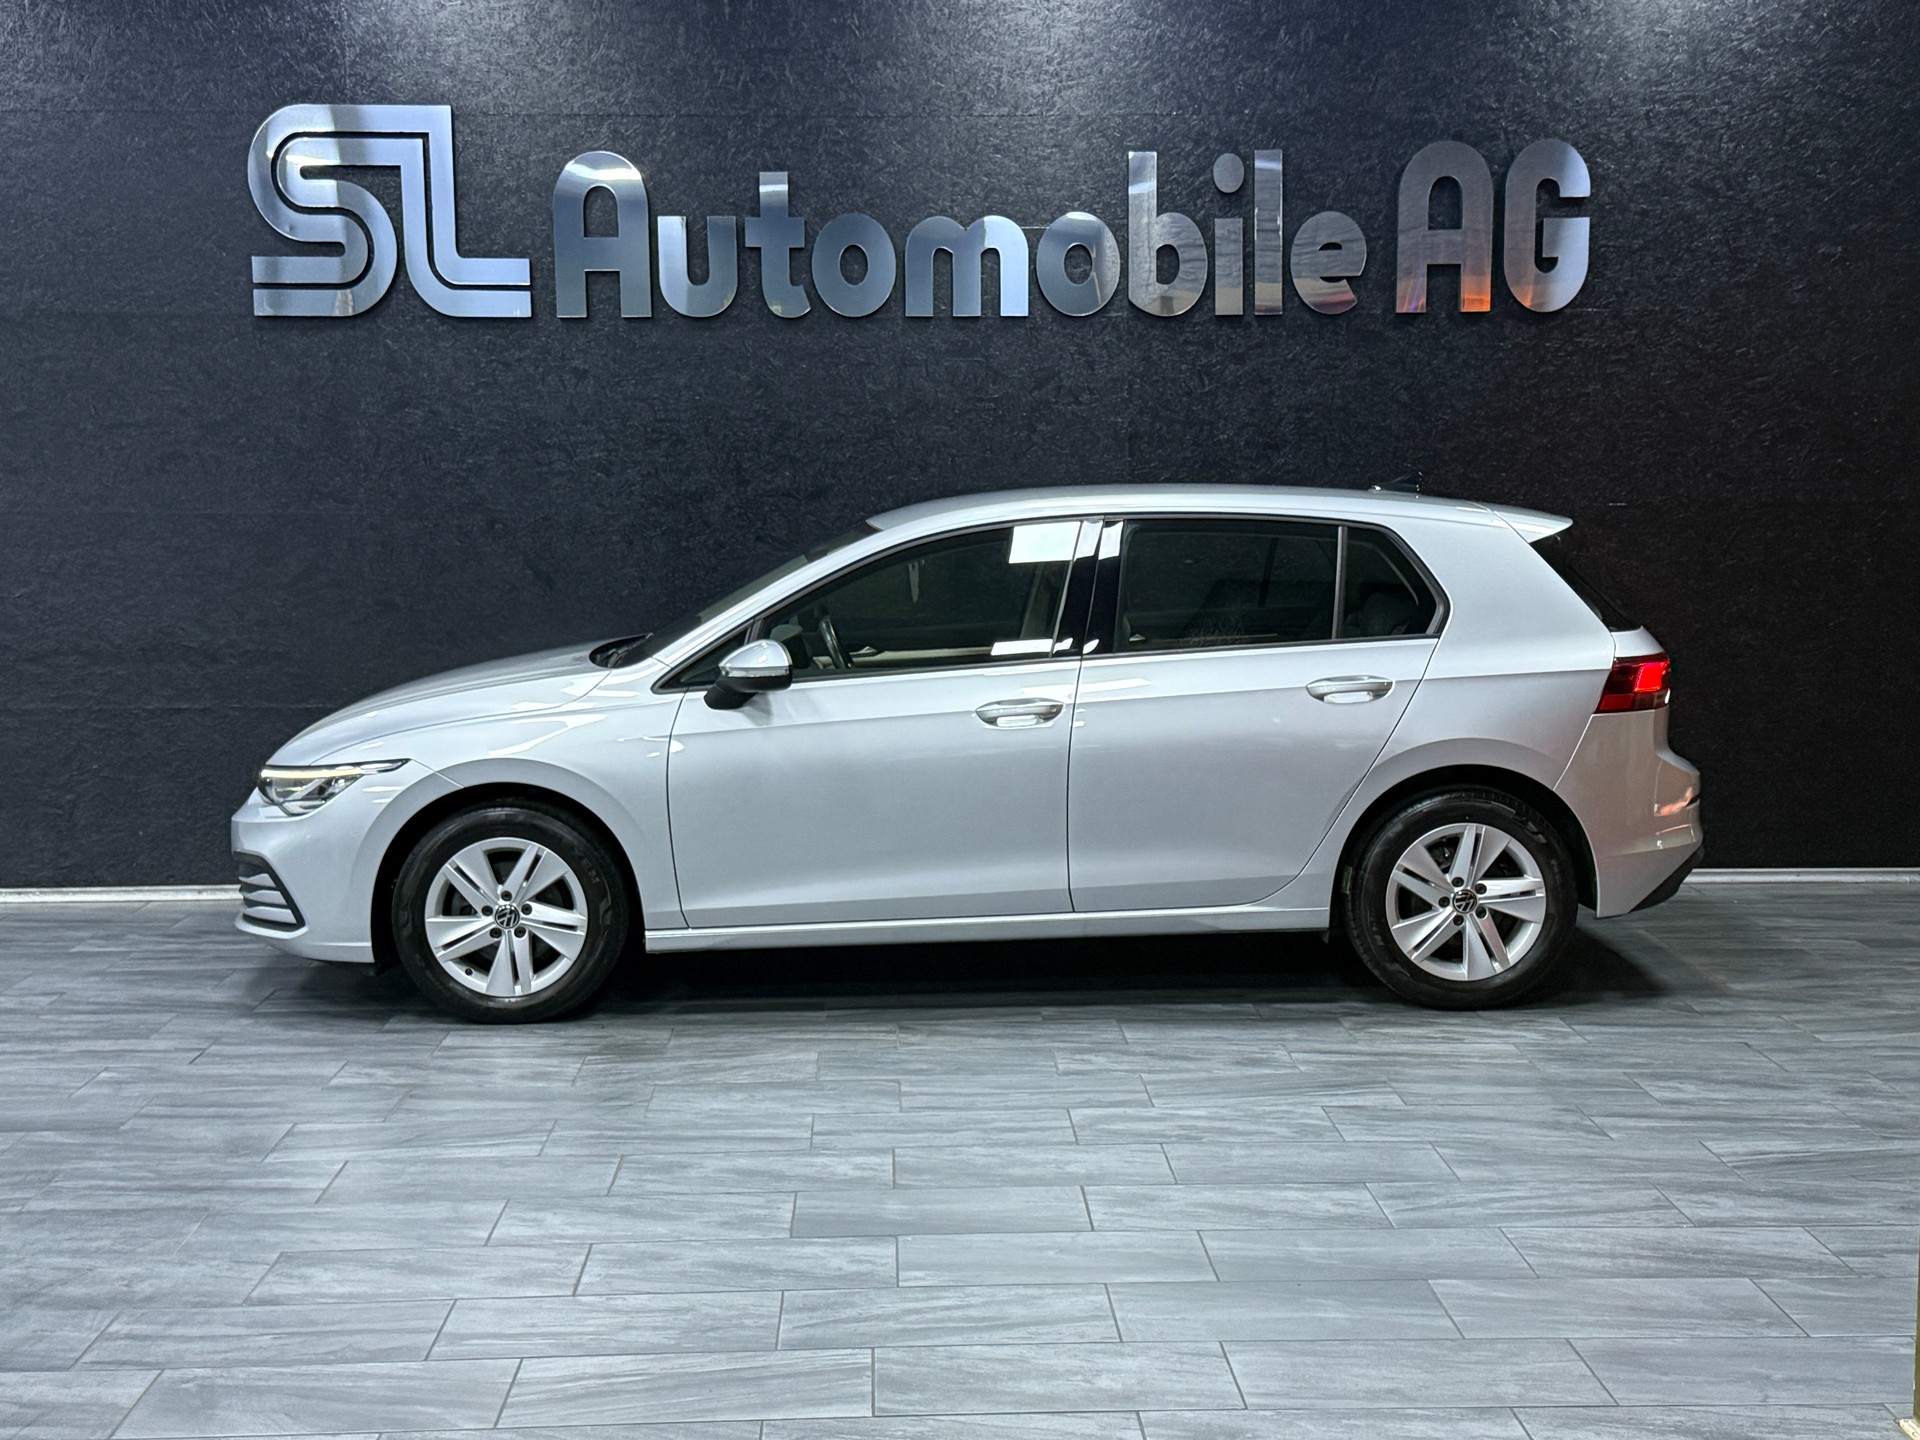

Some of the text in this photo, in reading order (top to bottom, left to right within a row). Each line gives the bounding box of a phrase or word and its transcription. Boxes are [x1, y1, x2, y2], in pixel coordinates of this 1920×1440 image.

[248, 104, 1591, 319] SL Automobile AG
